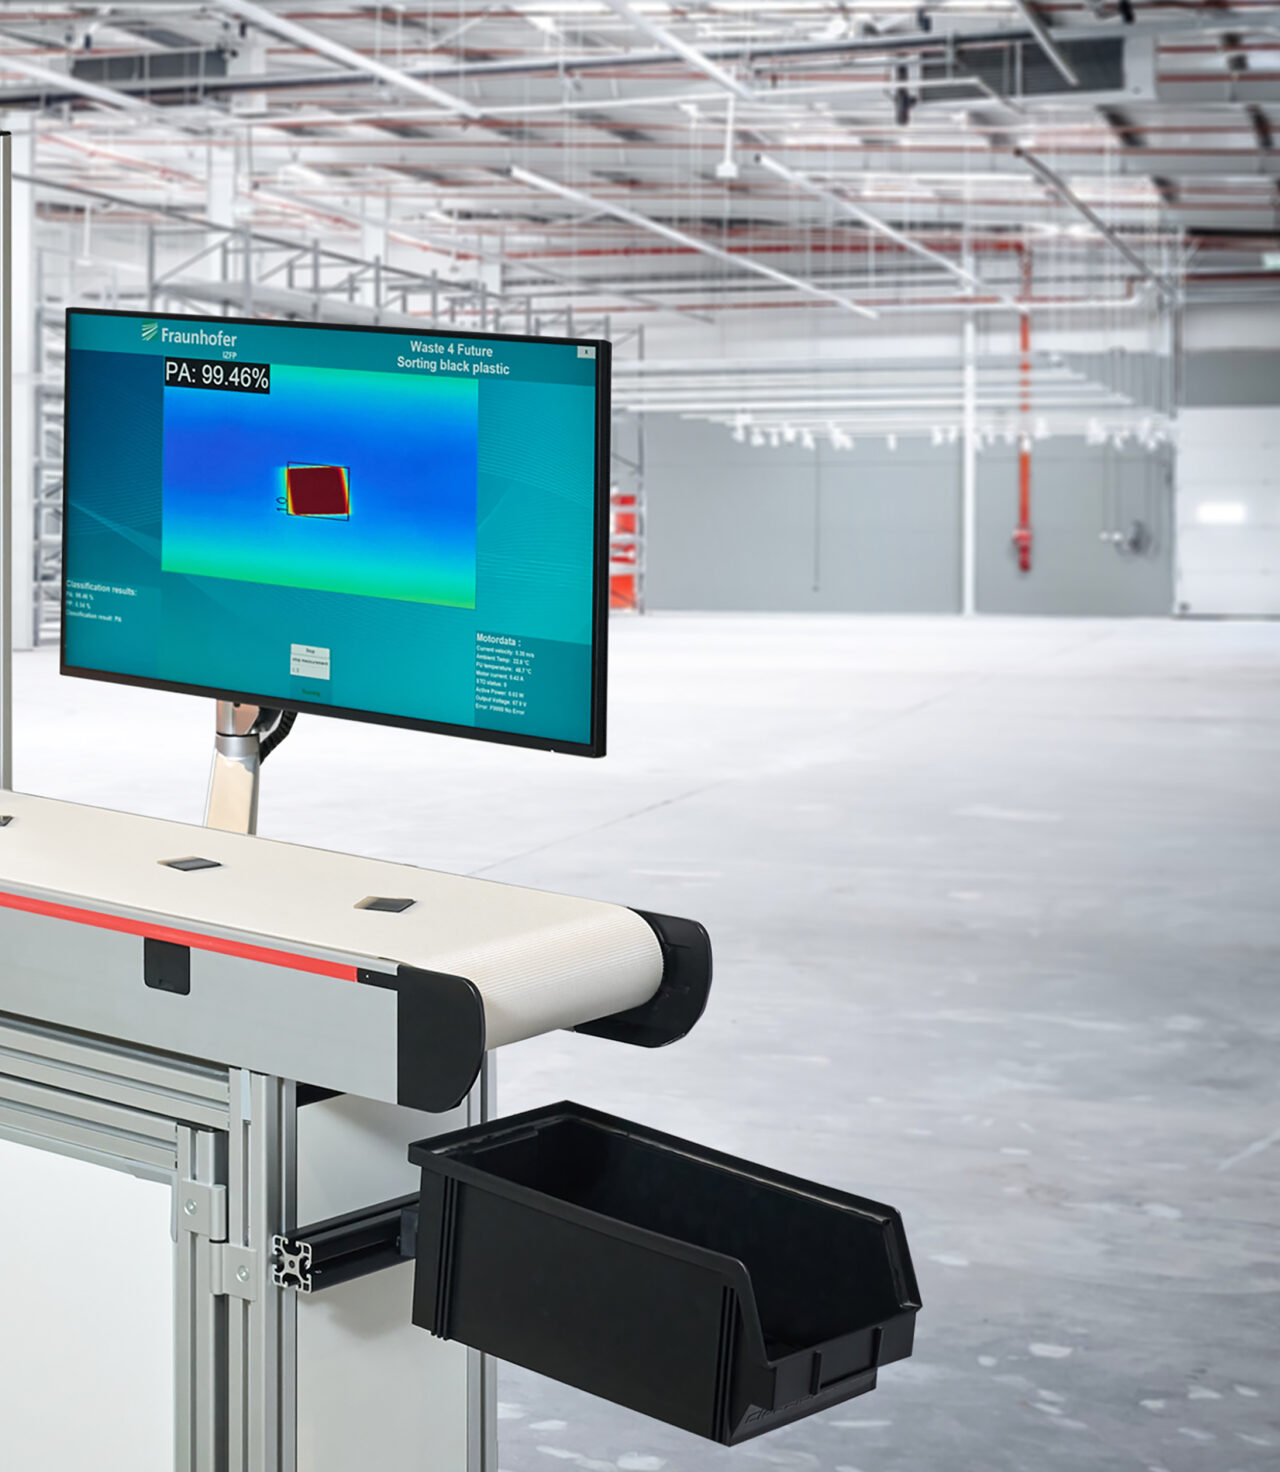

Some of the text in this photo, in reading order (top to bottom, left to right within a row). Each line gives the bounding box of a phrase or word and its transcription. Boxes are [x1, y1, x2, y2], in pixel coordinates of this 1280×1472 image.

[161, 327, 238, 348] Fraunhofer
[410, 340, 494, 357] Waste 4 Future
[165, 361, 269, 390] PA: 99.46%
[397, 355, 510, 376] Sorting black plastic
[476, 632, 516, 646] Motordata
